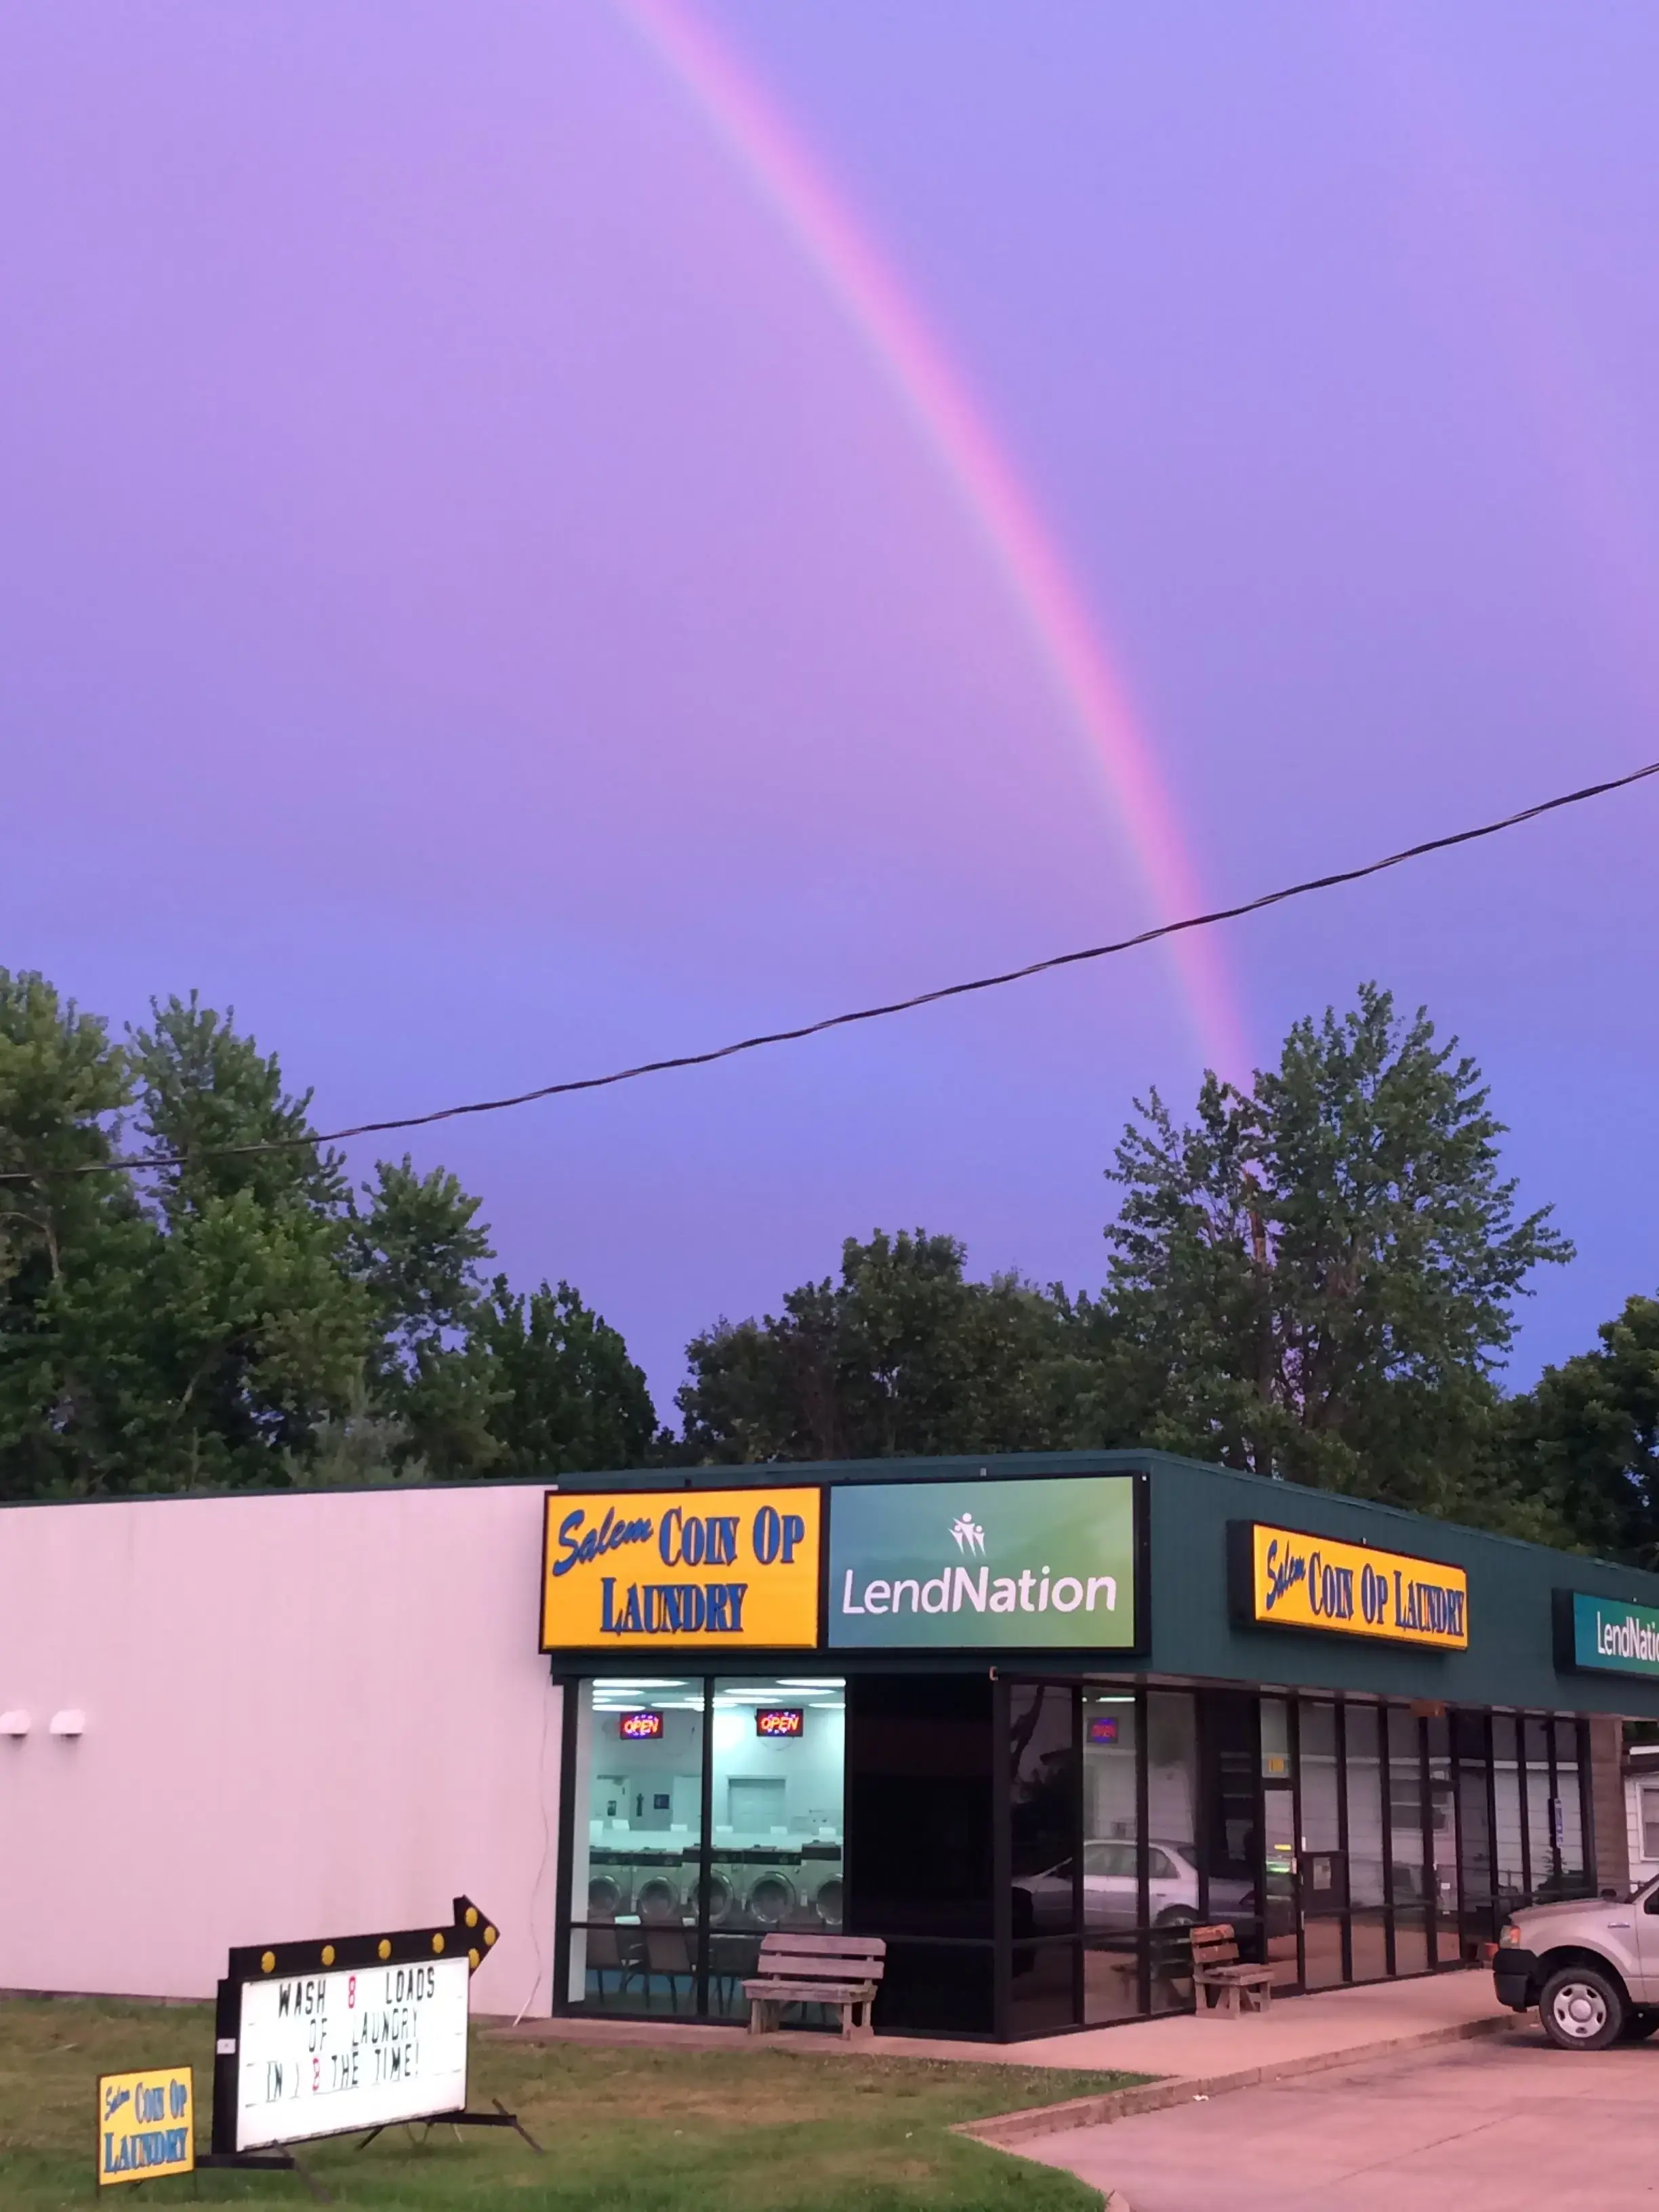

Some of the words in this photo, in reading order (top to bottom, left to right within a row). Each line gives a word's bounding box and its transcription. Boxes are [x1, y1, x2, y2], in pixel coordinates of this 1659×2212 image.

[553, 1507, 653, 1576] Salem
[659, 1506, 739, 1566] COIN
[753, 1505, 805, 1565] OP
[600, 1577, 747, 1637] LAUNDRY
[842, 1565, 1116, 1614] LendNation
[1266, 1539, 1306, 1611] Salem
[1309, 1551, 1354, 1620] COIN
[1361, 1563, 1388, 1624] OP
[1394, 1570, 1464, 1637] LAUNDRY
[624, 1718, 659, 1734] OPEN
[760, 1716, 799, 1730] OPEN
[279, 1980, 326, 2018] WASH
[348, 1976, 356, 2009] 8
[386, 1967, 435, 2004] LOADS
[309, 2018, 327, 2053] OF
[352, 2007, 419, 2047] LAUNDRY
[267, 2062, 283, 2102] IN
[331, 2051, 359, 2088] THE
[374, 2040, 420, 2083] TIME!
